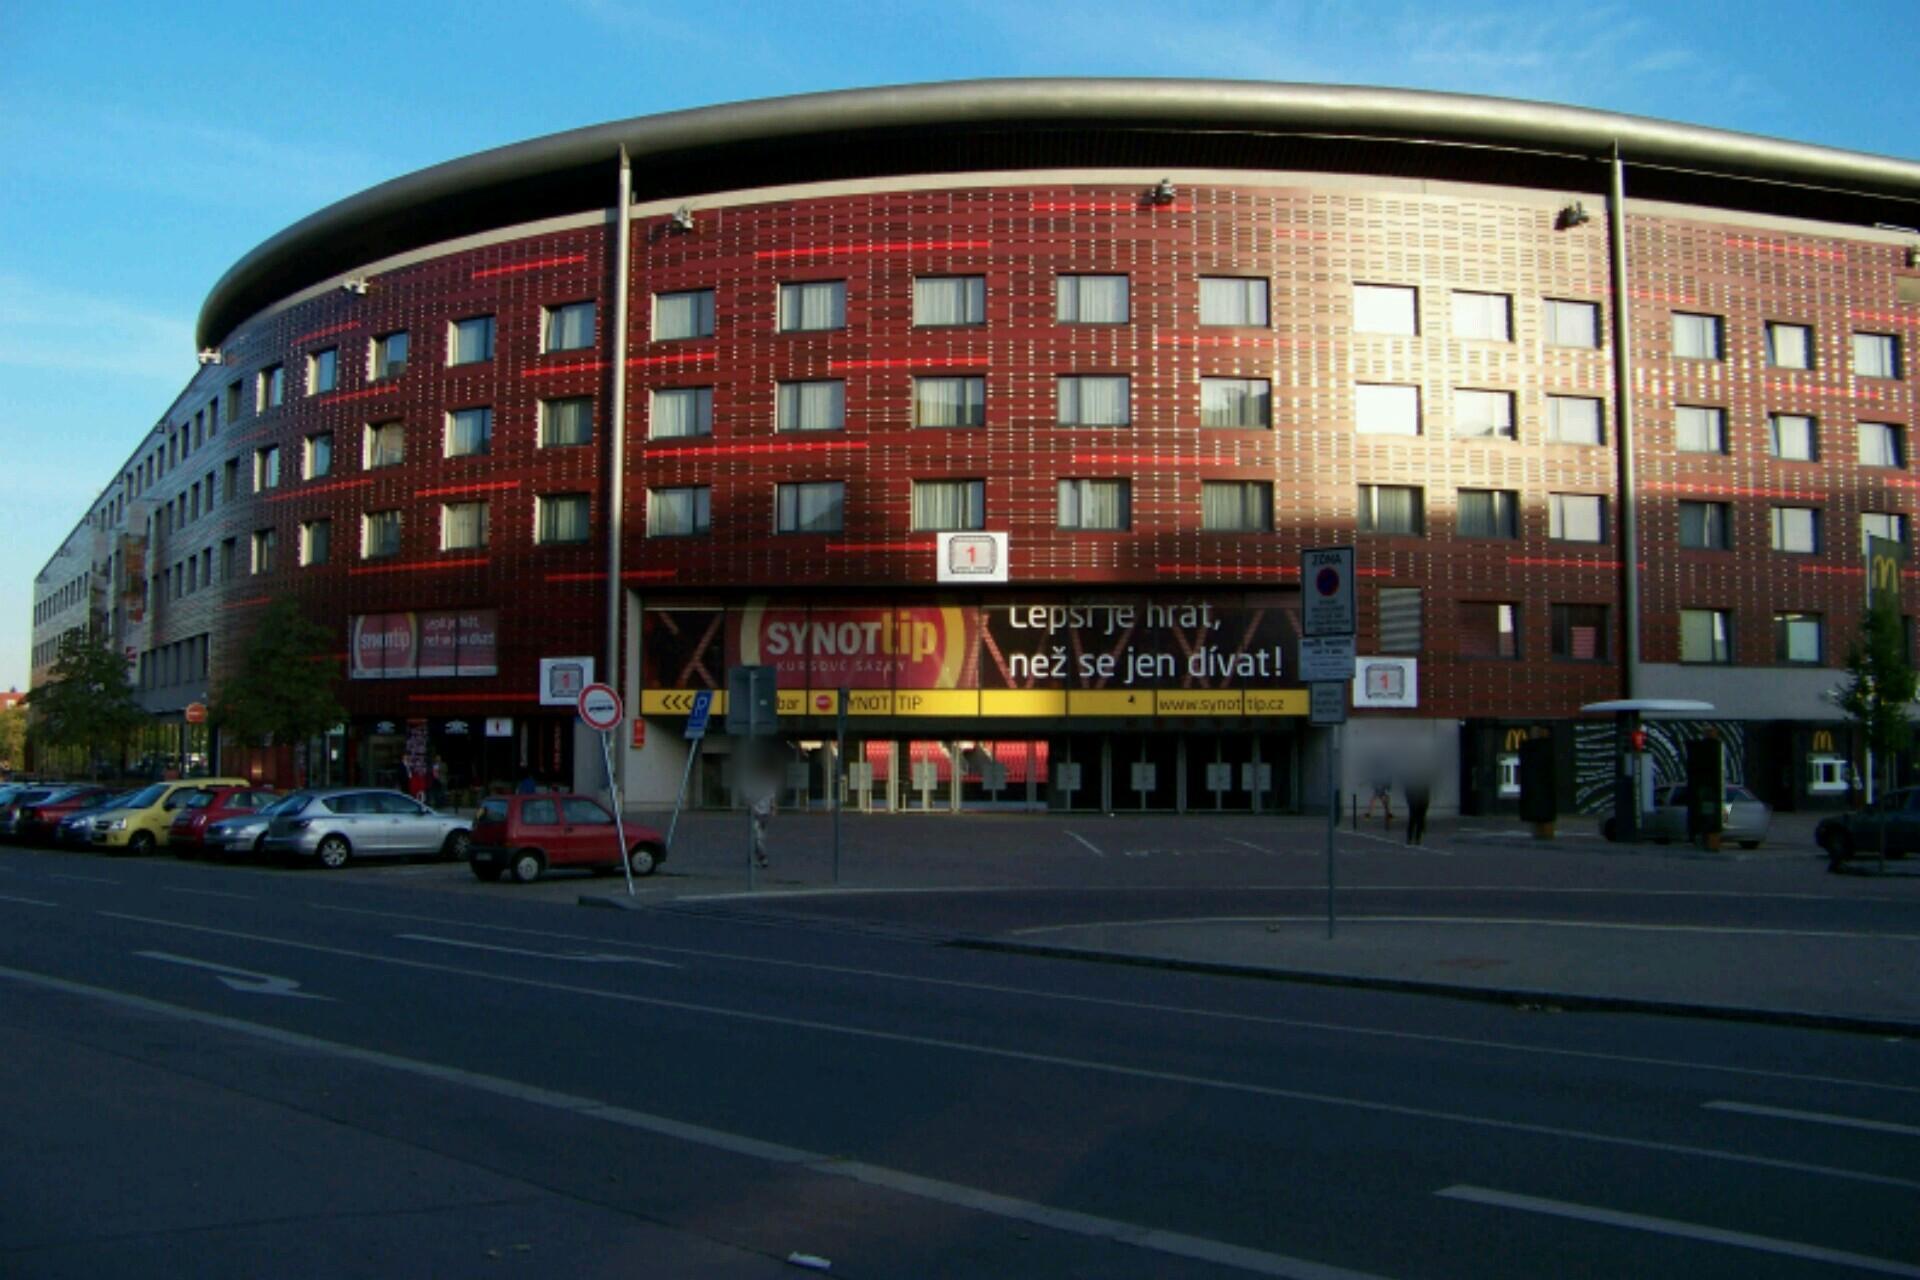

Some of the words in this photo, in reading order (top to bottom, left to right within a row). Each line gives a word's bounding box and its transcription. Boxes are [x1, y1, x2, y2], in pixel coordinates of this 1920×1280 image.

[967, 545, 976, 565] 1
[1104, 599, 1135, 635] je
[1009, 645, 1067, 677] než
[1079, 653, 1115, 677] se
[1123, 646, 1175, 684] jen
[1187, 645, 1282, 677] dívat!
[1379, 672, 1389, 689] 1
[848, 695, 889, 710] YNOT
[900, 695, 923, 711] TIP
